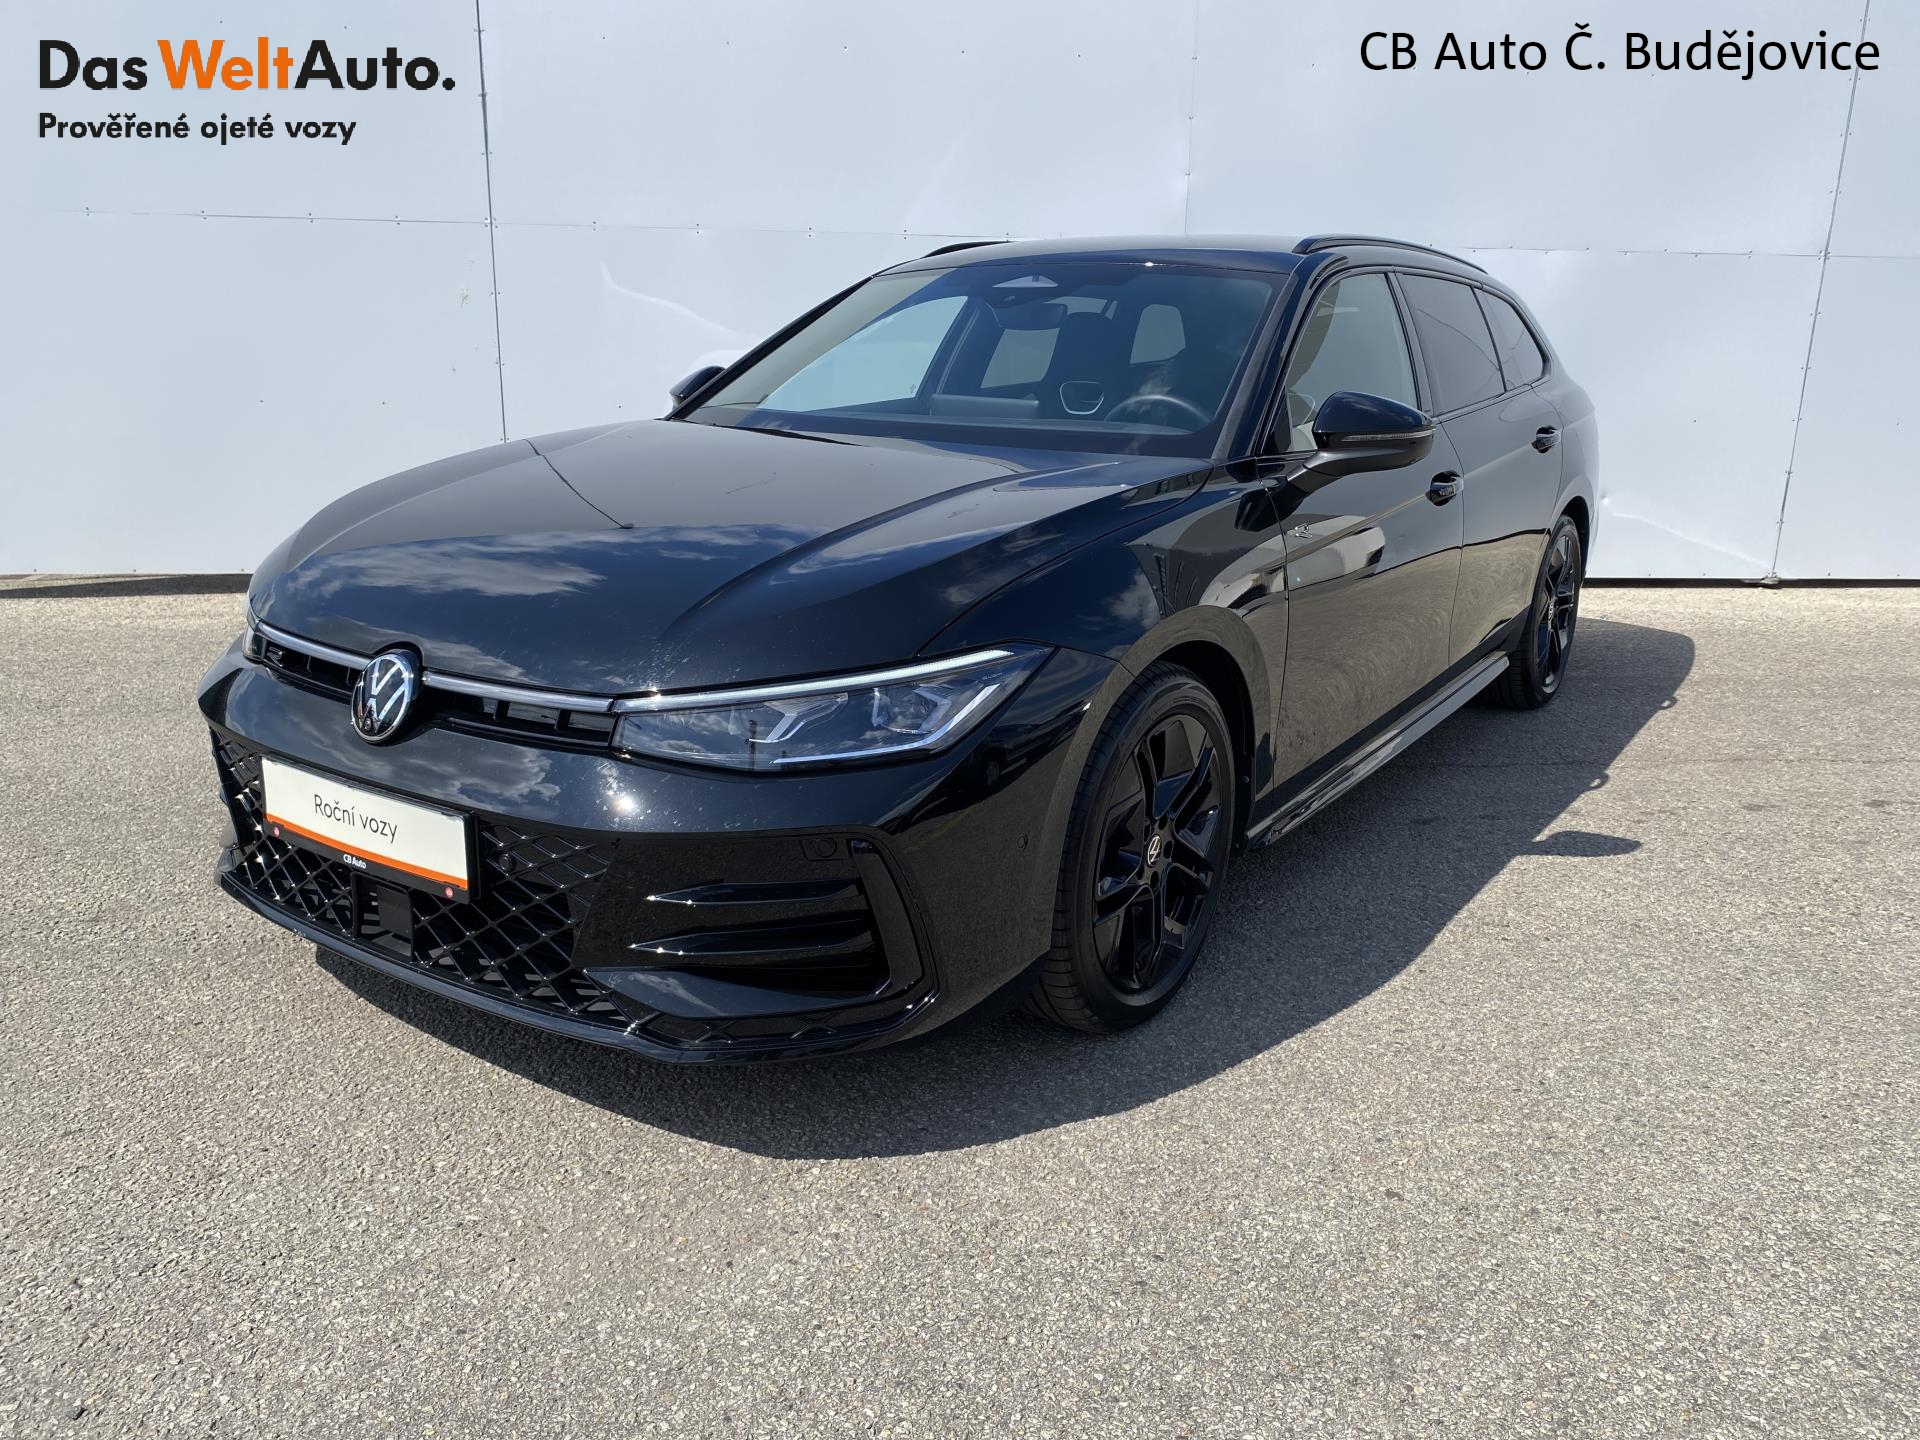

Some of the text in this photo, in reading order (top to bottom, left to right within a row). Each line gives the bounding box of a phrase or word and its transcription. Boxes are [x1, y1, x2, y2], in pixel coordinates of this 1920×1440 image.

[313, 793, 398, 844] Roční vozy
[343, 853, 367, 869] CB Auto
